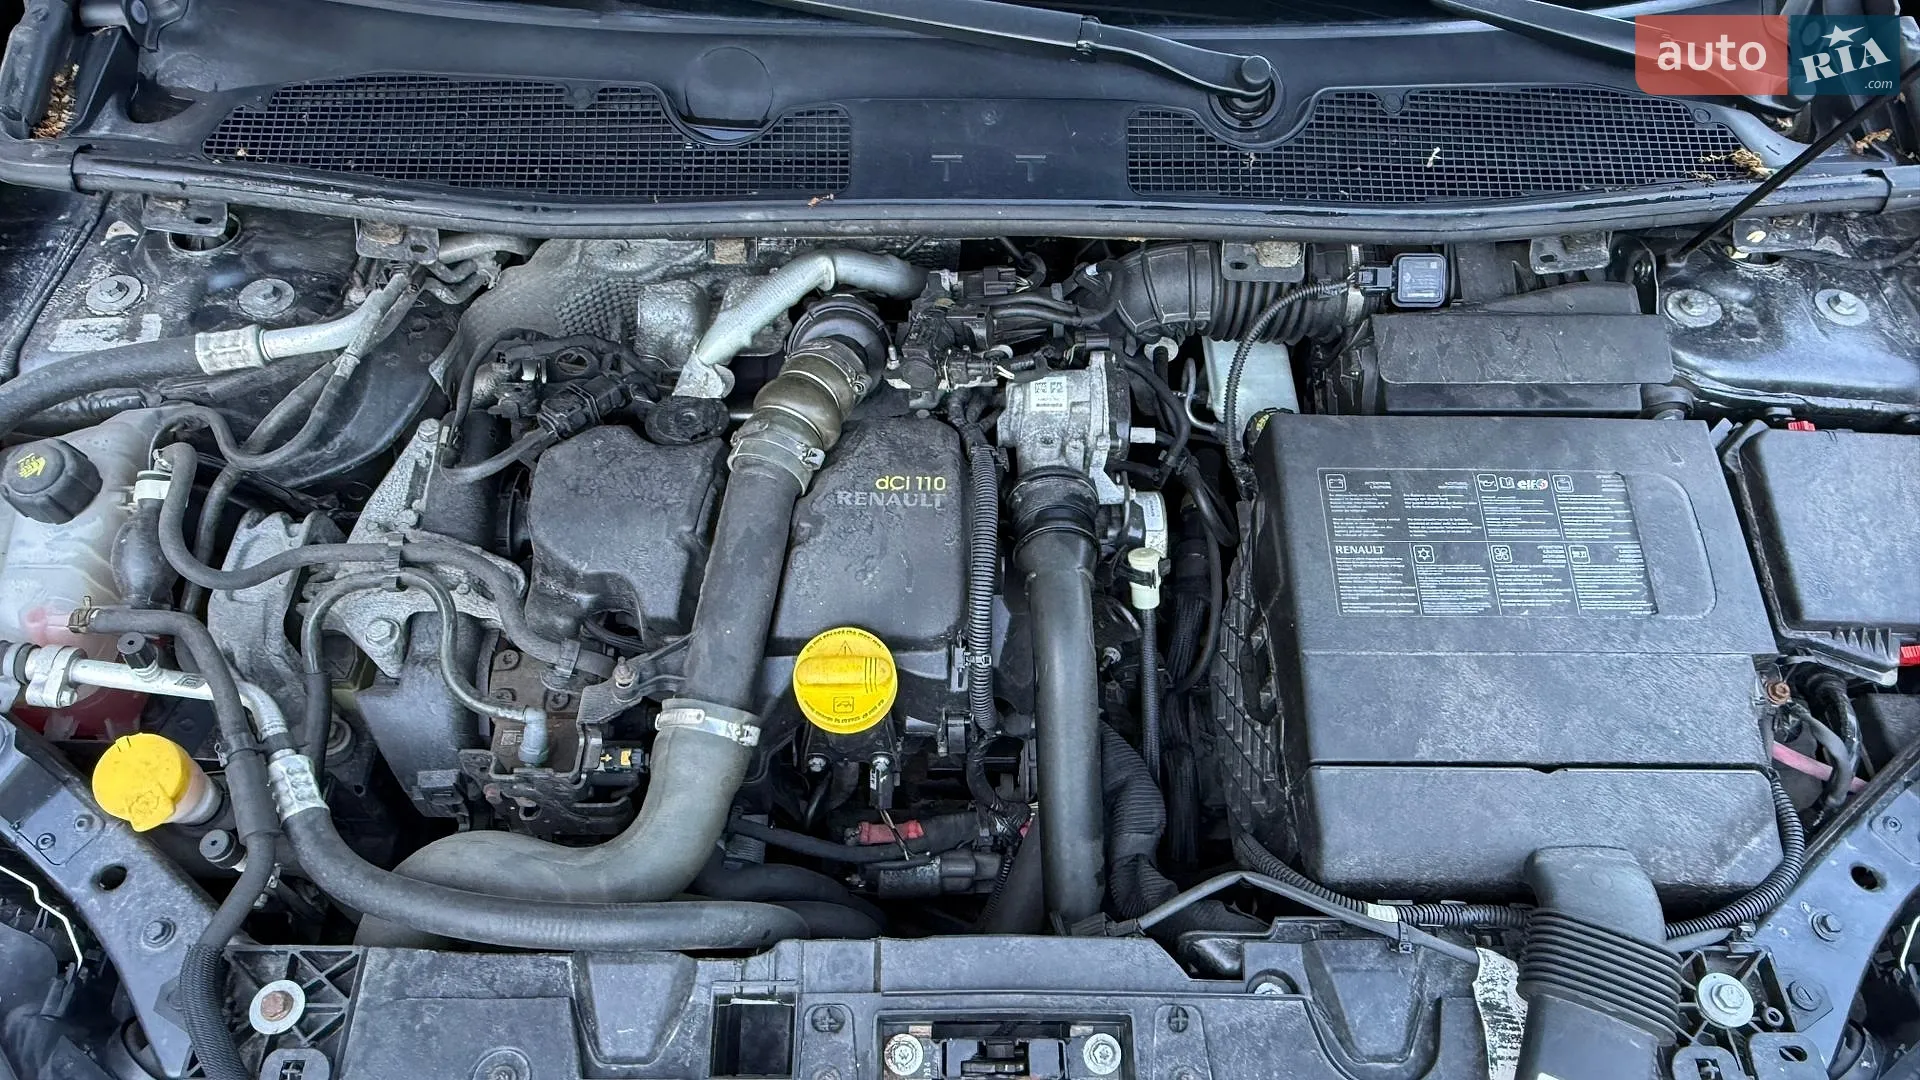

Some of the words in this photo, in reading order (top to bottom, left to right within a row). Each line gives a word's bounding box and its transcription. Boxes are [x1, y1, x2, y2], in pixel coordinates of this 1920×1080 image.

[875, 475, 910, 492] dCi
[916, 476, 946, 492] 110
[835, 490, 947, 509] RENAULT
[1335, 545, 1385, 555] RENAULT
